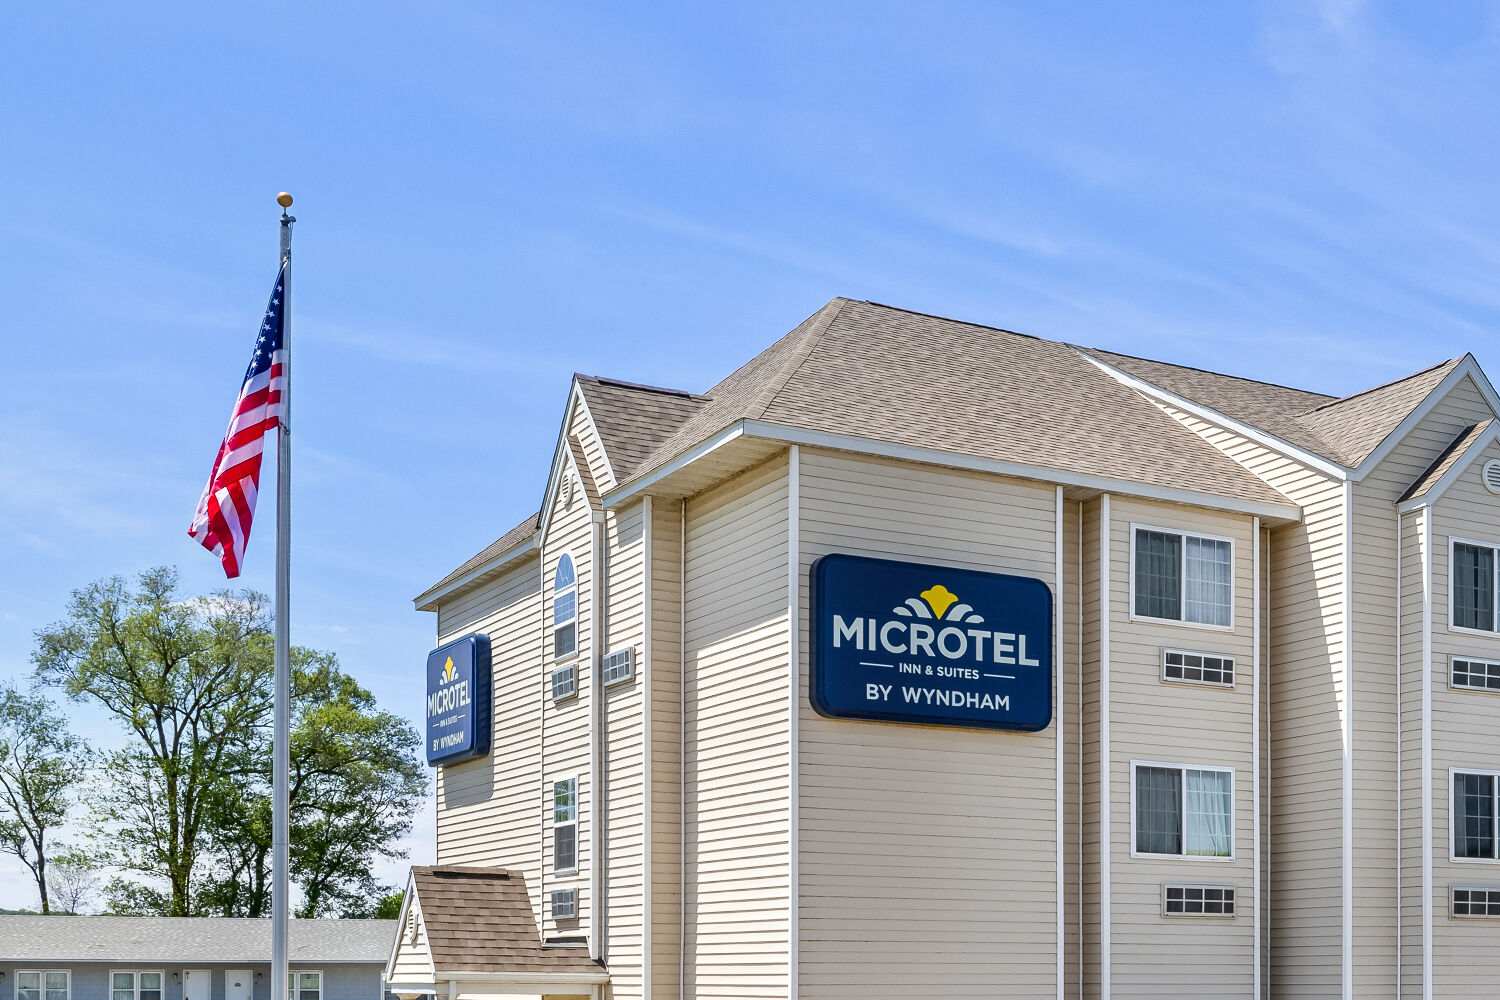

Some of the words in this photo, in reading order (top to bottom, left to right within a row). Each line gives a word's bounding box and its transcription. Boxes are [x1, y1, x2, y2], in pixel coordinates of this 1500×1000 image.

[833, 614, 1040, 667] MICROTEL
[899, 662, 922, 675] INN
[924, 665, 934, 676] &
[936, 666, 980, 680] SUITES
[427, 679, 471, 718] MICROTEL
[866, 683, 892, 701] BY
[901, 686, 1010, 711] WYNDHAM
[433, 738, 439, 752] BY
[440, 730, 464, 749] WYNDHAM
